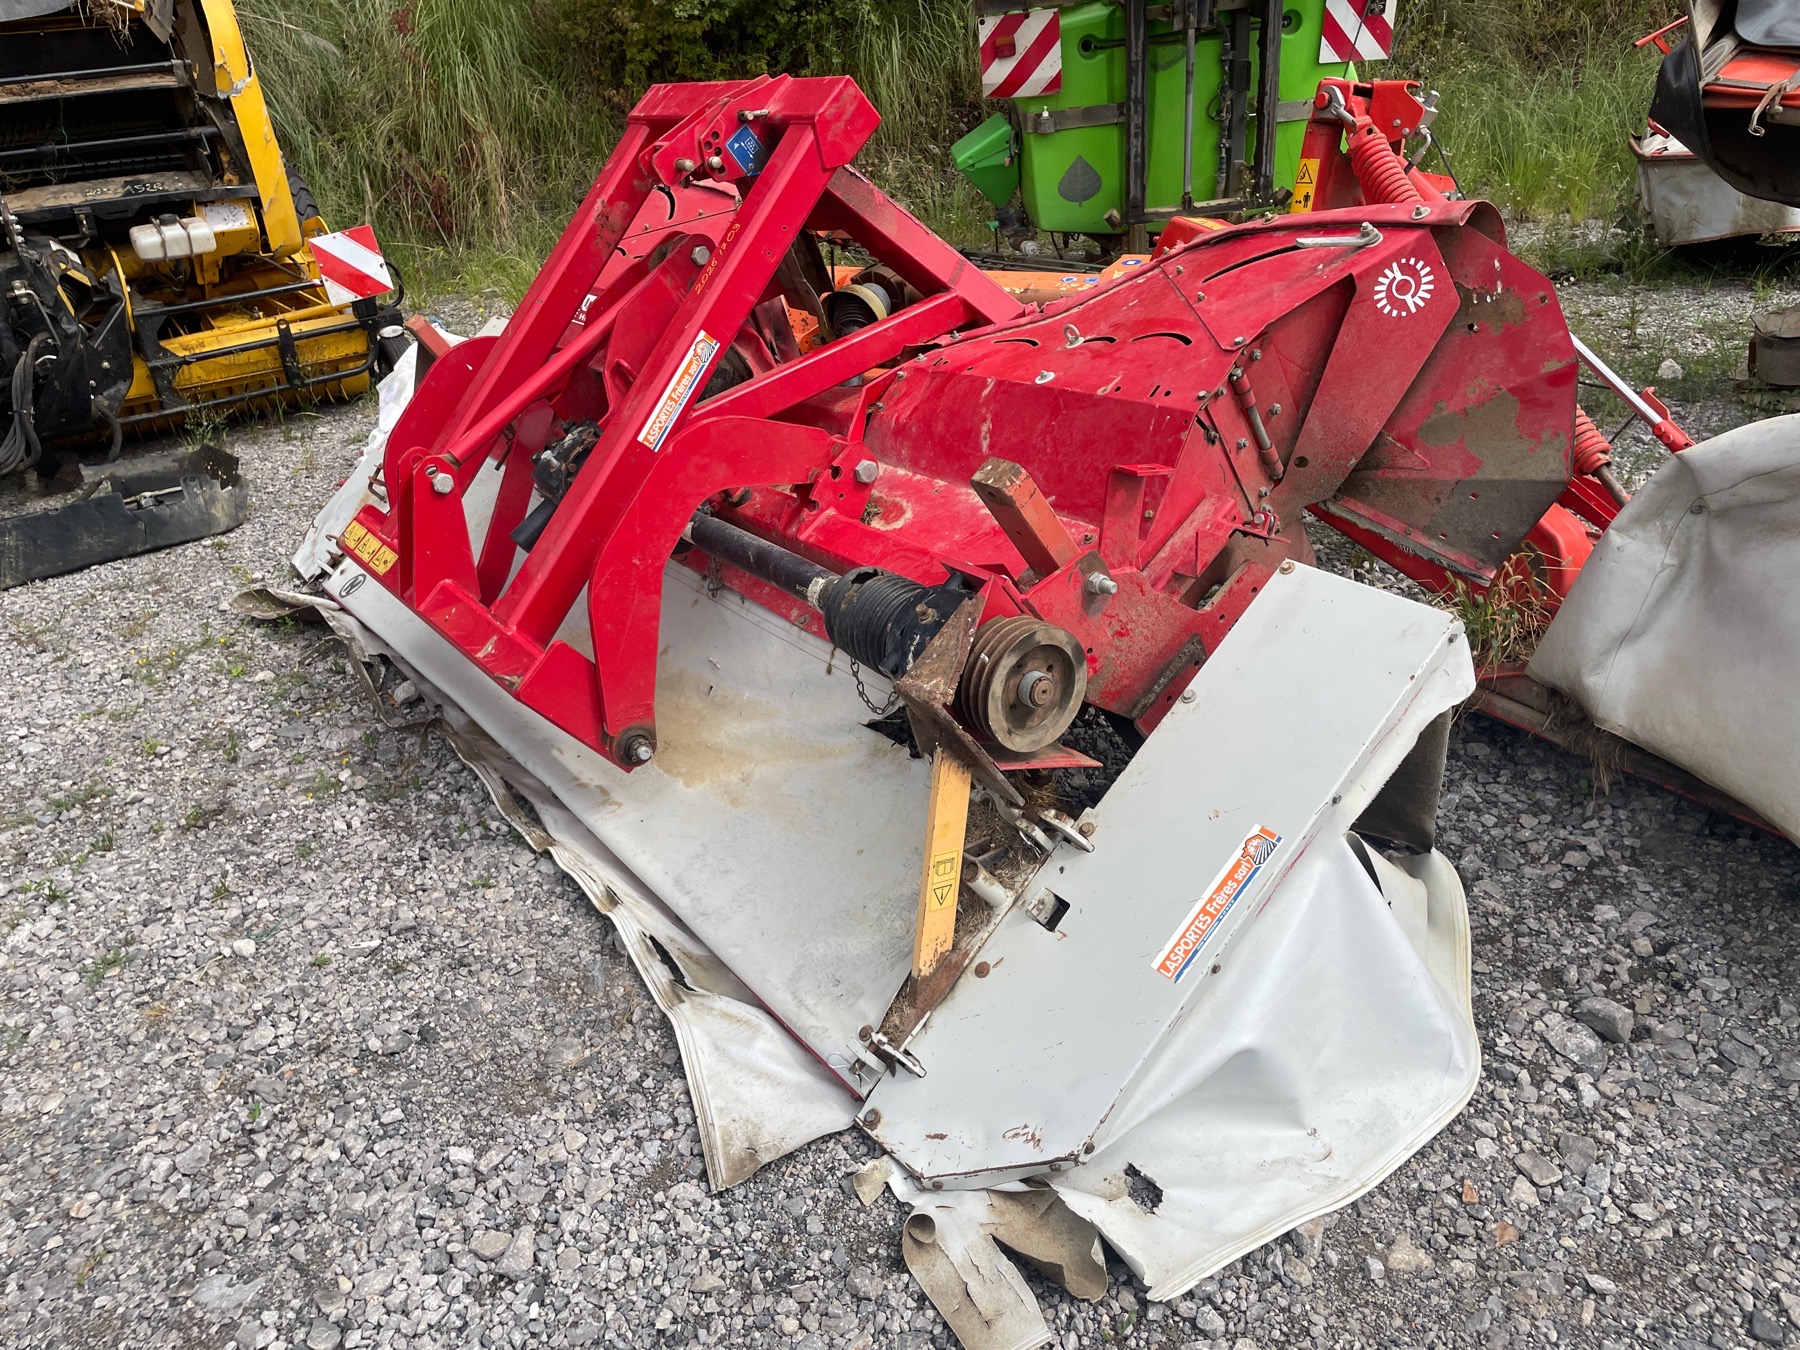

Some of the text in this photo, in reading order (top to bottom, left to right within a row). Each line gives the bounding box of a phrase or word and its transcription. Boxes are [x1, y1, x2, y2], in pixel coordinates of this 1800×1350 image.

[695, 257, 717, 294] 2026
[643, 400, 676, 448] LASPORTES
[671, 374, 691, 401] Frères
[688, 359, 700, 376] sarl
[1159, 913, 1212, 978] LASPORTES
[1205, 879, 1238, 915] Frères
[1234, 860, 1252, 881] sarl
